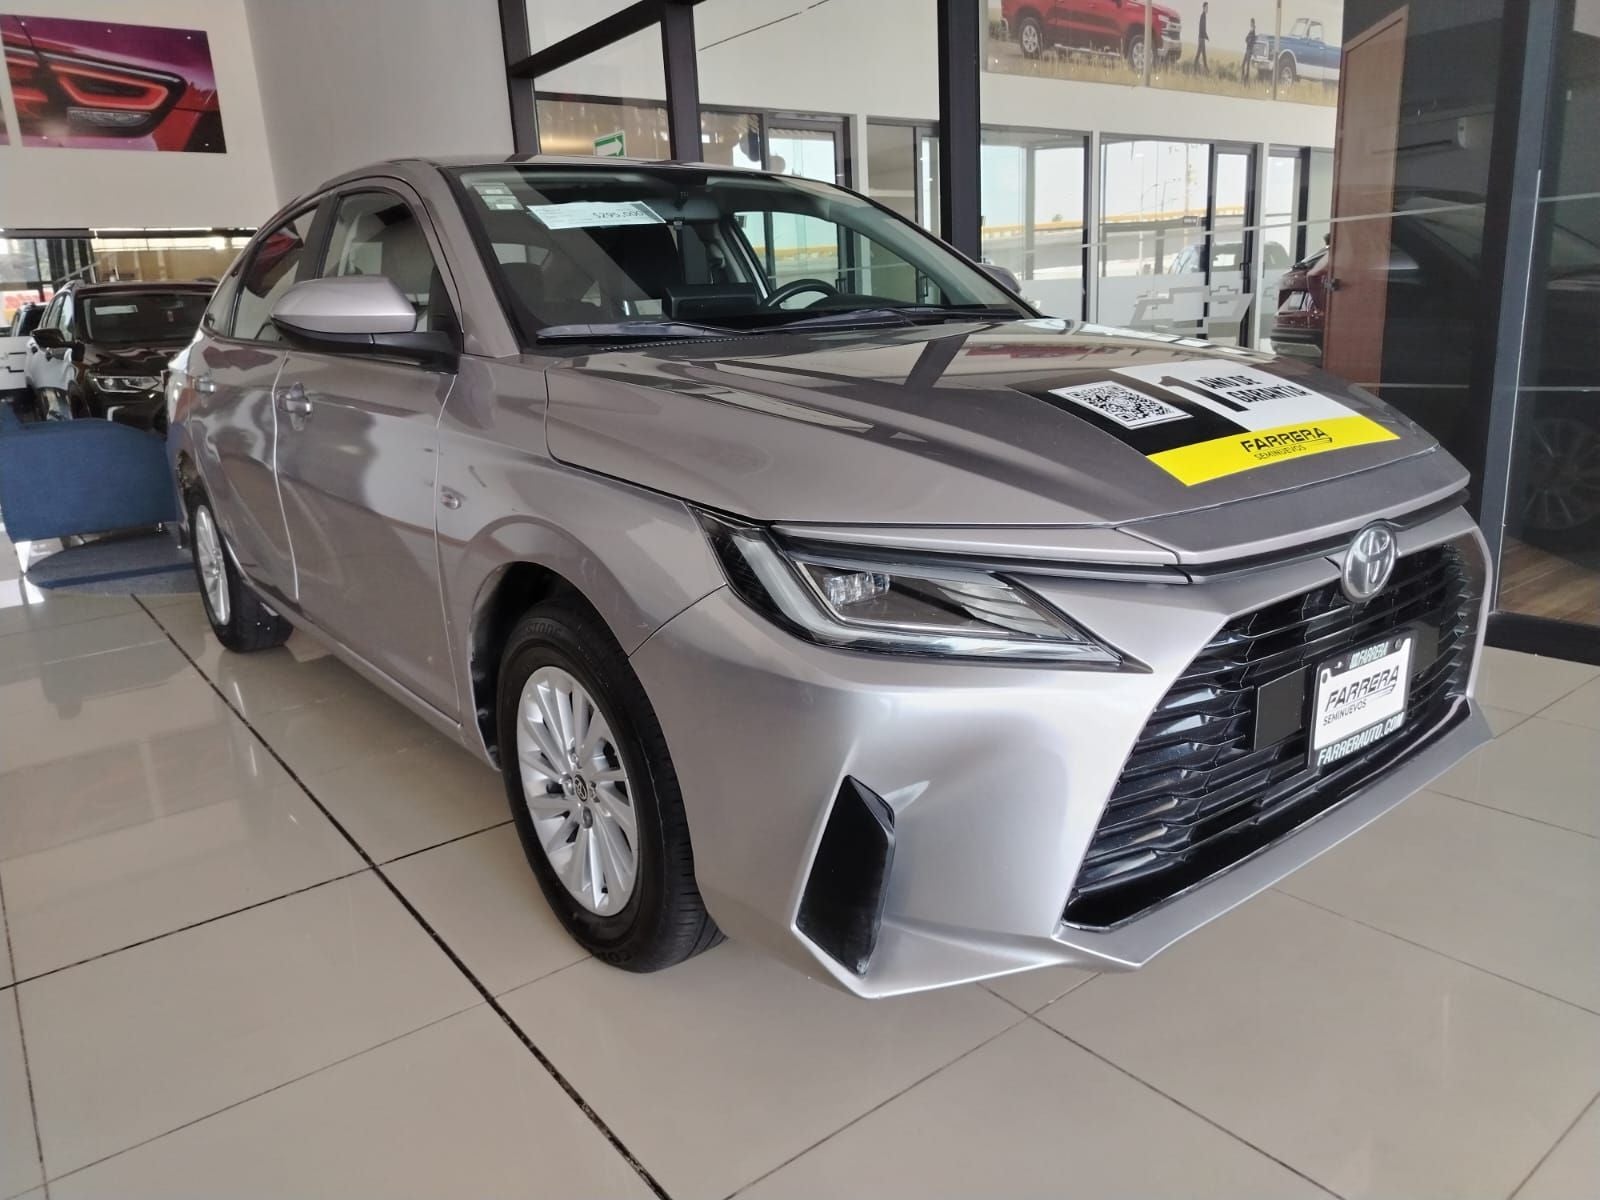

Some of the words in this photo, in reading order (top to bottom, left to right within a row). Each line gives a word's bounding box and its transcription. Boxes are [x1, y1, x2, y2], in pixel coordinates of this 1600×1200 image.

[1228, 375, 1263, 385] DE
[1240, 427, 1329, 452] FARRERA
[1254, 445, 1307, 460] SEMINUEVOS
[1325, 665, 1400, 712] FARRERA
[1323, 699, 1367, 726] SEMINUEVOS
